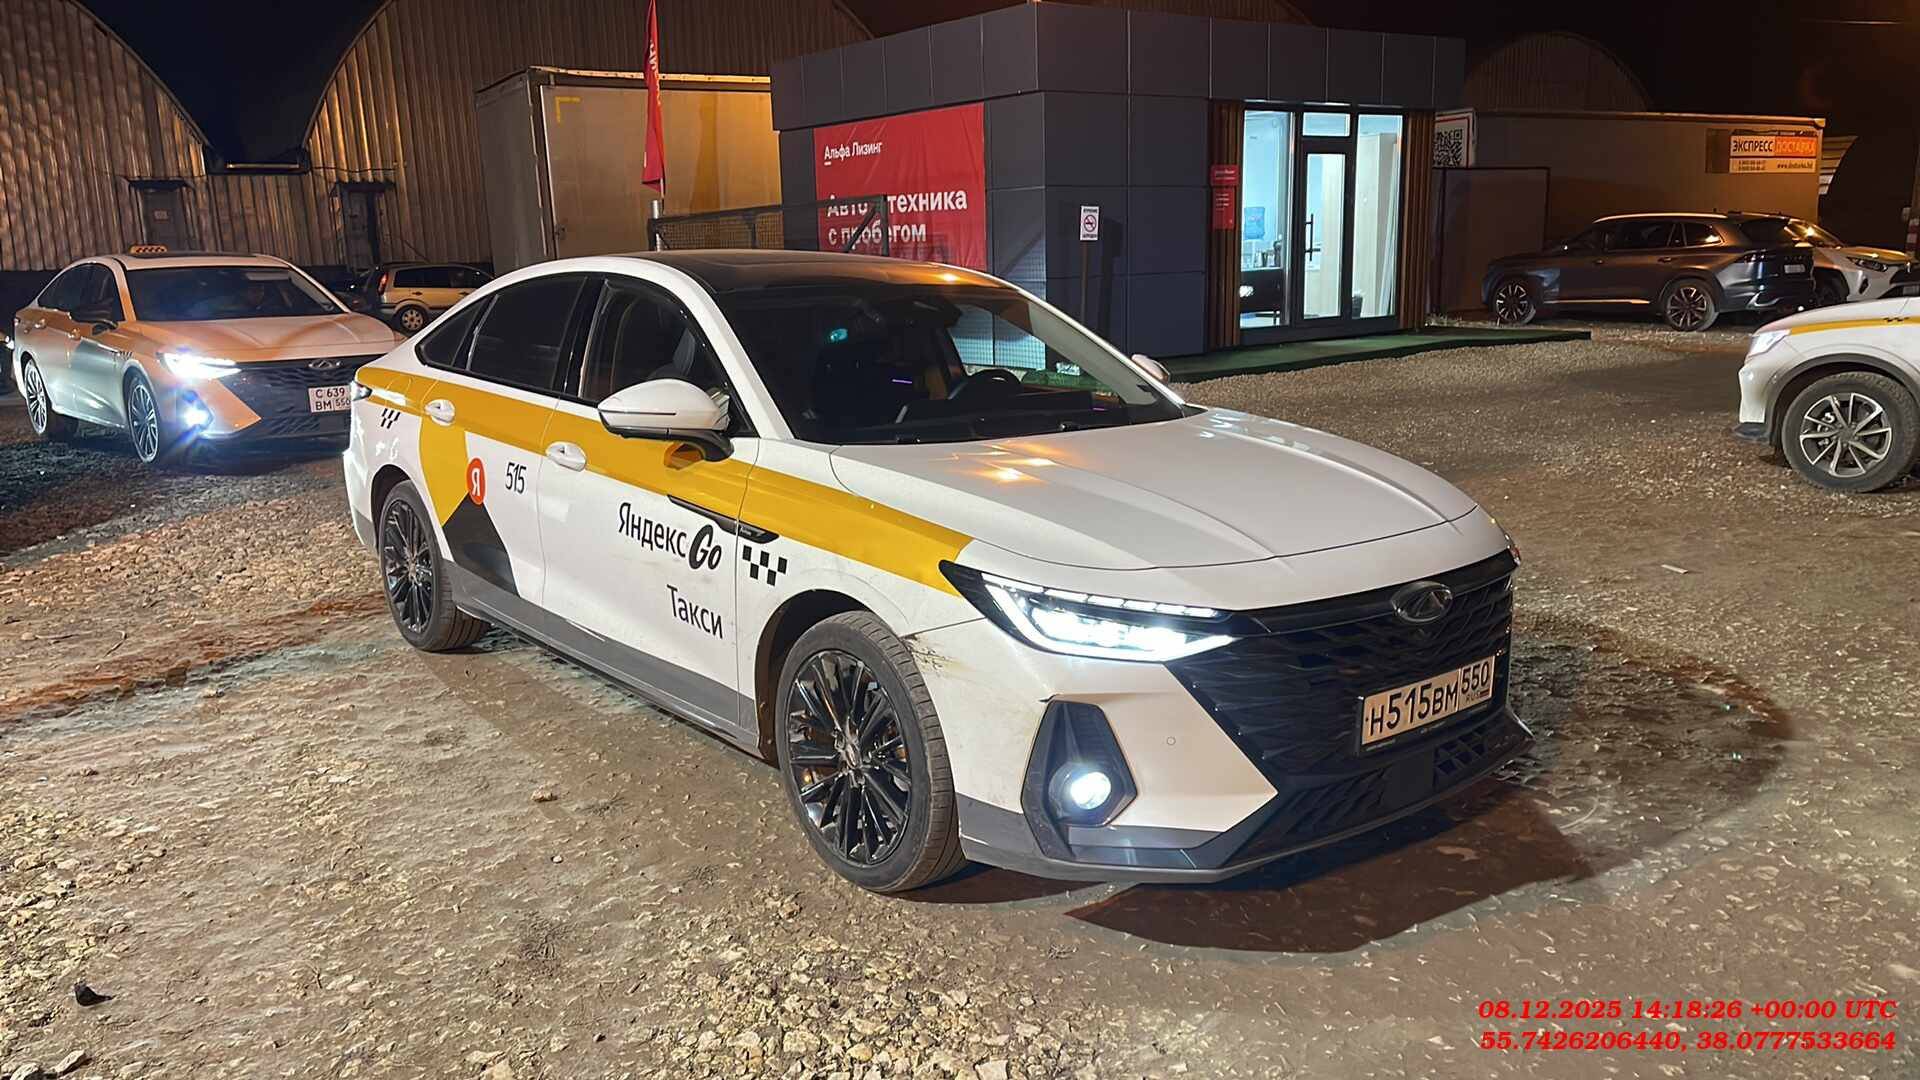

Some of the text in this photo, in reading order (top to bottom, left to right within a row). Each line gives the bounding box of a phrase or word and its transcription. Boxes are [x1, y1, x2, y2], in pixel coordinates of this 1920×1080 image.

[824, 141, 882, 162] Альфа Лизинг
[1732, 140, 1774, 153] ЭКСПРЕСС
[887, 190, 968, 214] техника
[828, 228, 838, 246] с
[326, 387, 346, 398] 639
[315, 400, 332, 411] ВМ
[505, 461, 527, 495] 515
[618, 502, 722, 570] Яндекс Go
[666, 583, 723, 640] Такси
[1370, 661, 1489, 736] Н515ВМ 550
